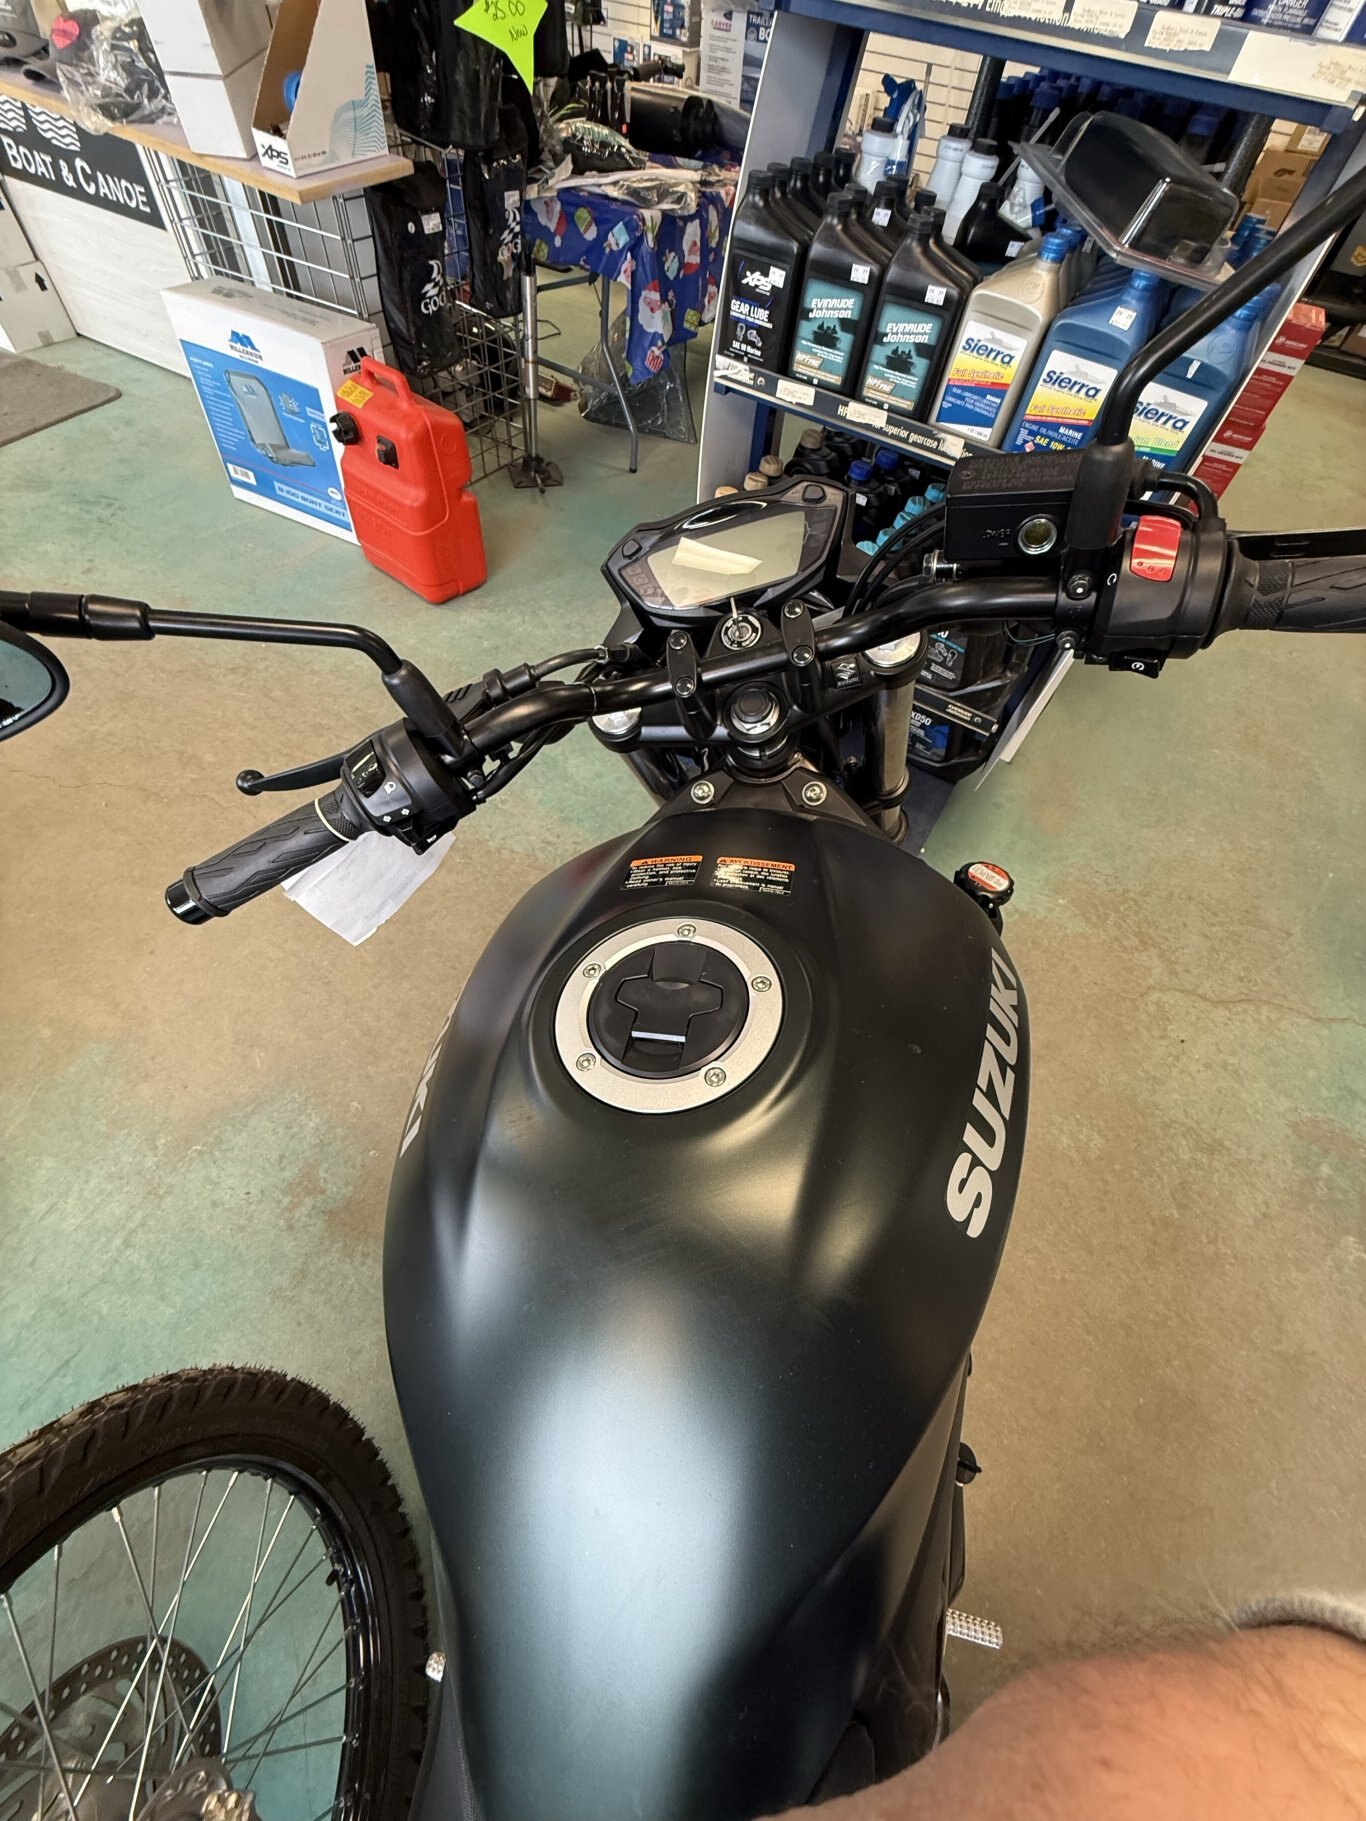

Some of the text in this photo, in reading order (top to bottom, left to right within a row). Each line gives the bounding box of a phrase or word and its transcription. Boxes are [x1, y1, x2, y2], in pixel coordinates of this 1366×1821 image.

[262, 144, 289, 165] XPS
[0, 133, 151, 213] BOAT & CANOE
[741, 270, 773, 291] XPS
[730, 299, 751, 315] GEAR
[750, 303, 770, 322] LUBE
[808, 308, 852, 319] Johnson
[811, 298, 855, 309] EVINRUDE
[882, 333, 929, 344] Johnson
[886, 322, 933, 334] EVINRUDE
[962, 337, 1016, 366] sierra
[1042, 369, 1102, 400] sierra
[1133, 400, 1191, 431] sierra
[882, 423, 909, 439] superior
[909, 432, 938, 449] gearcase
[1034, 435, 1049, 446] SAE
[1058, 426, 1084, 440] MARINE
[650, 856, 693, 864] WARNING
[729, 859, 793, 869] AVERTISSEMENT
[946, 946, 1019, 1239] SUZUKI
